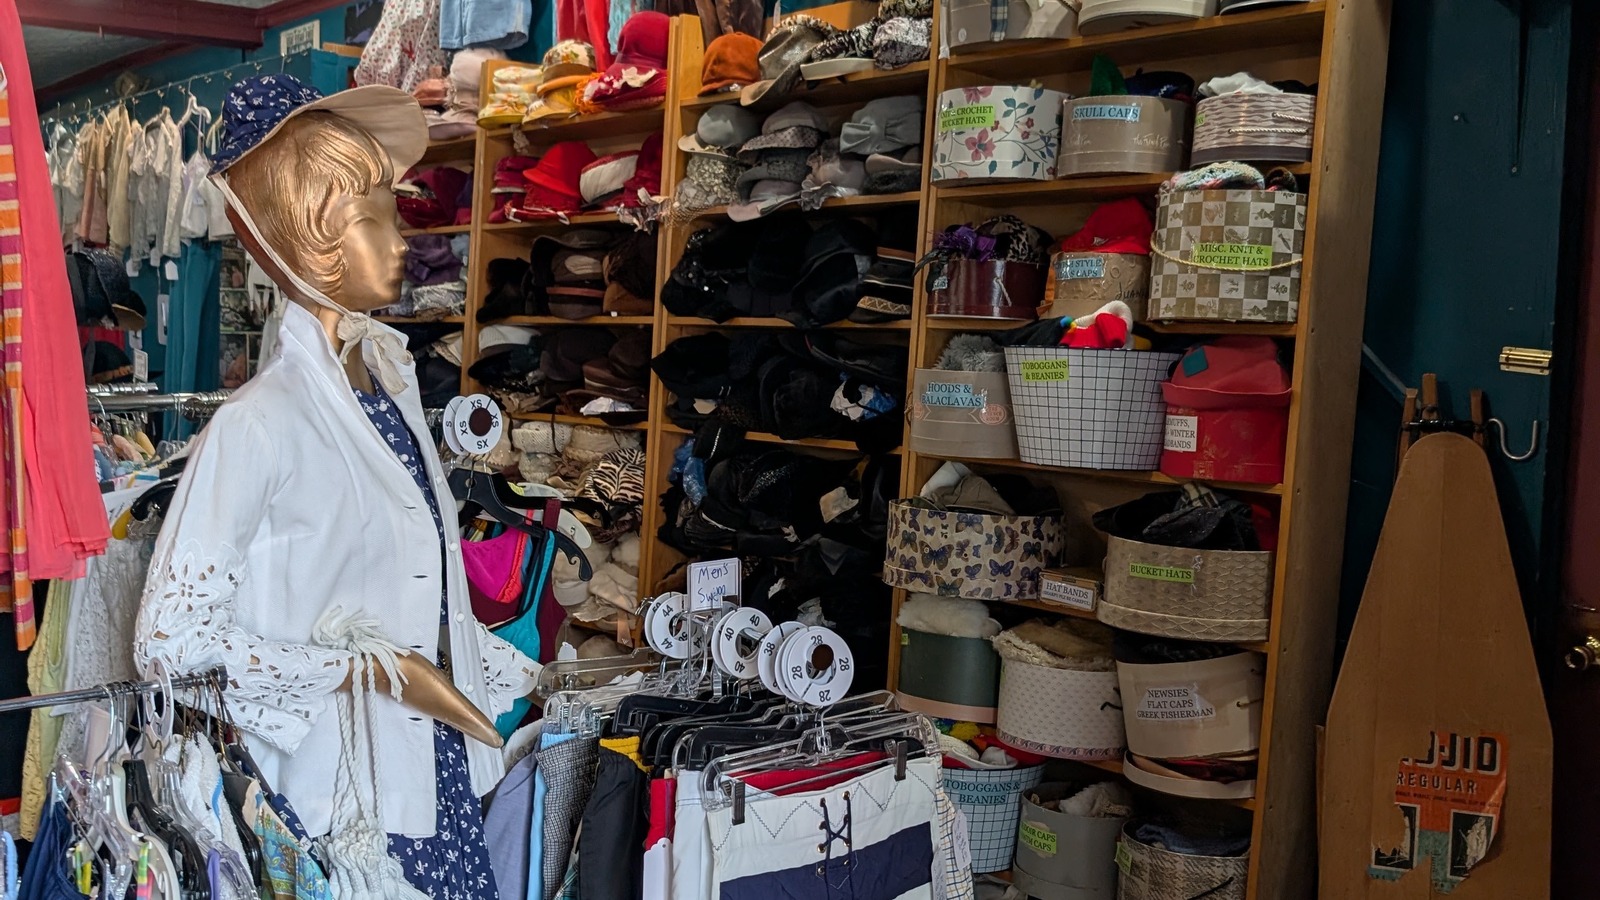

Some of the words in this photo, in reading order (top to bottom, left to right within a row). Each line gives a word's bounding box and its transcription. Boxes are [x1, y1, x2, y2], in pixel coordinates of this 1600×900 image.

[957, 106, 993, 115] CROCHET
[1074, 107, 1105, 118] SKULL
[1108, 106, 1139, 119] CAPS
[965, 116, 986, 125] HATS
[1200, 244, 1226, 253] MISC.
[1229, 245, 1254, 254] KNIT
[1256, 246, 1264, 255] &
[1075, 259, 1102, 268] STYLE
[1194, 255, 1240, 265] CROCHET
[1242, 257, 1269, 267] HATS
[1076, 269, 1098, 278] CAPS
[1022, 360, 1067, 370] TOBOGGANS
[1026, 372, 1031, 380] &
[1032, 371, 1065, 380] BEANIES
[928, 383, 961, 394] HOODS
[963, 385, 971, 394] &
[470, 399, 483, 410] XS
[922, 394, 982, 407] BALACLAVAS
[490, 413, 499, 428] XS
[460, 420, 469, 436] XS
[477, 439, 489, 450] XS
[1130, 564, 1164, 577] BUCKET
[1166, 569, 1192, 580] HATS
[1046, 582, 1063, 593] HAT
[1063, 586, 1089, 599] BANDS
[662, 604, 674, 617] 44
[750, 614, 760, 627] 40
[725, 627, 735, 641] 40
[661, 637, 673, 650] 44
[811, 635, 823, 646] 28
[764, 642, 776, 656] 38
[735, 661, 745, 673] 40
[839, 657, 850, 671] 28
[791, 665, 803, 680] 28
[819, 689, 831, 702] 28
[1147, 688, 1189, 698] NEWSIES
[1147, 700, 1168, 709] FLAT
[1169, 699, 1194, 709] CAPS
[1137, 710, 1160, 719] GREEK
[1160, 708, 1213, 719] FISHERMAN
[944, 779, 1012, 793] TOBOGGANS
[1013, 781, 1020, 790] &
[1397, 771, 1477, 794] REGULAR
[959, 793, 1007, 804] BEANIES
[1036, 831, 1056, 843] CAPS
[1033, 839, 1052, 852] CAPS
